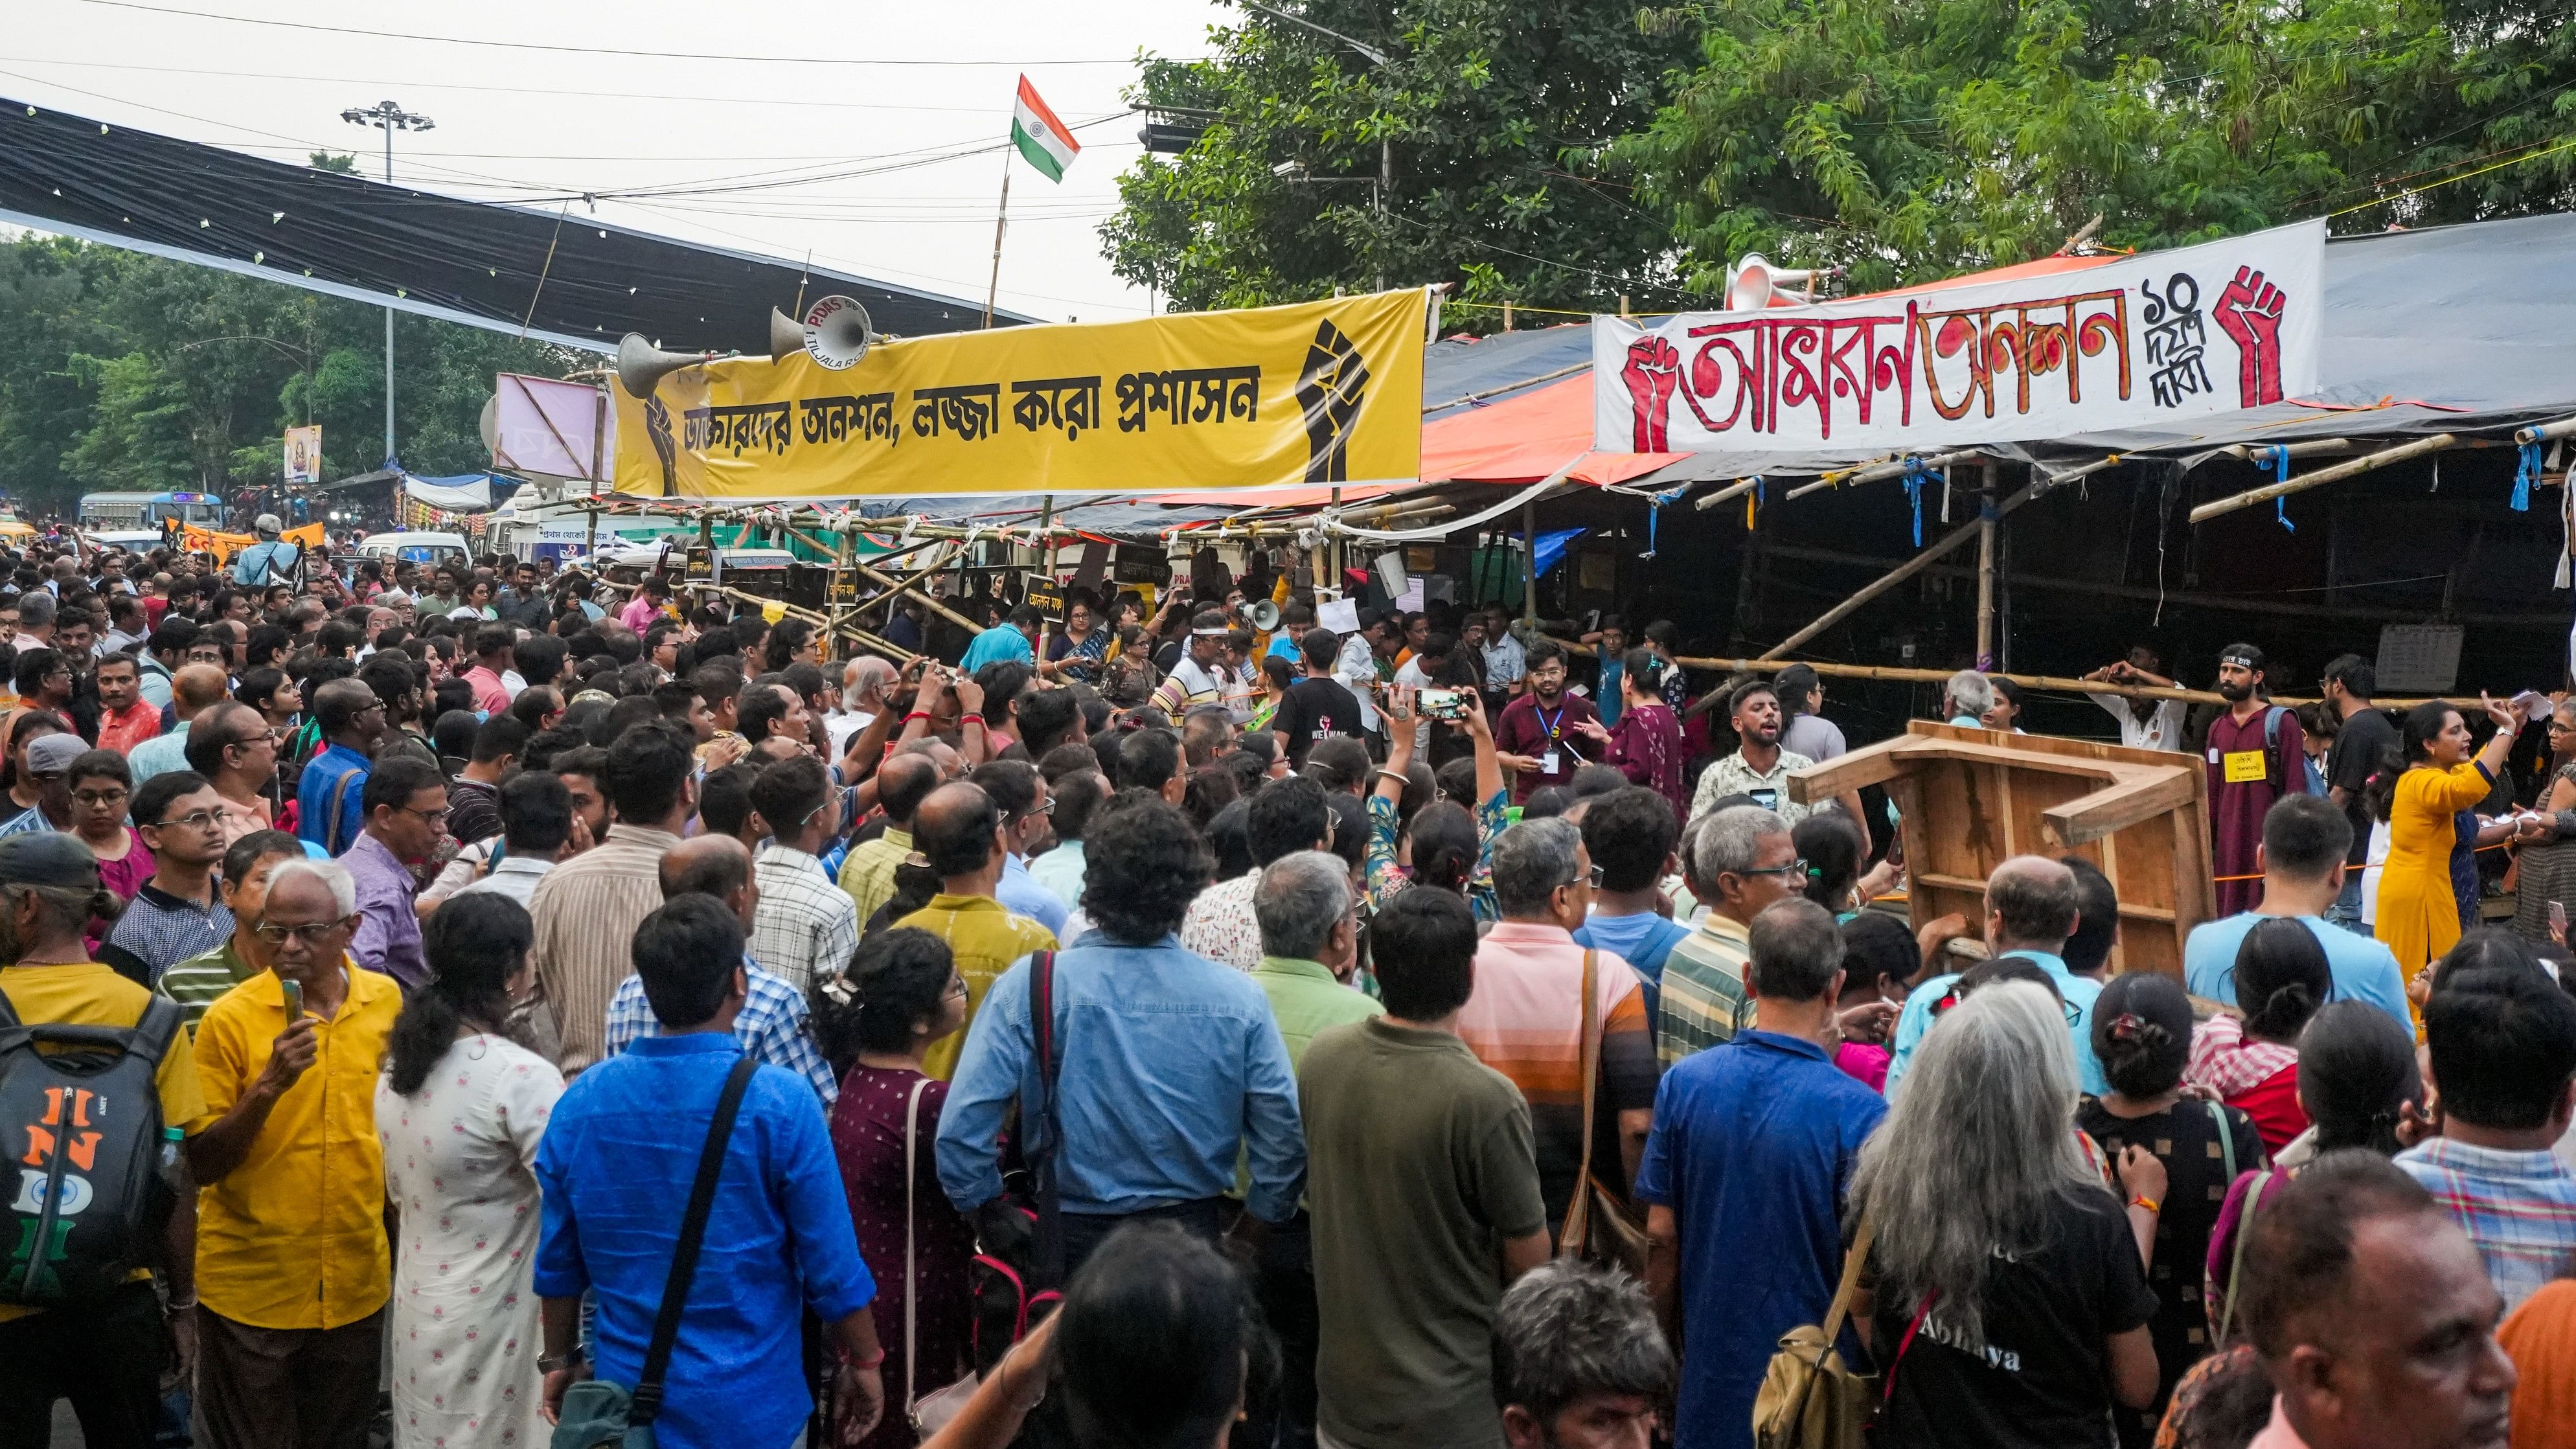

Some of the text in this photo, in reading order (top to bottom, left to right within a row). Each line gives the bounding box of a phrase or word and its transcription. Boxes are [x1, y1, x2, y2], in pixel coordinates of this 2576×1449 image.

[2141, 272, 2200, 325] ১০
[807, 339, 842, 368] TILJALA
[1917, 288, 2132, 420] অনশন
[684, 401, 791, 458] ডাক্তারদের
[799, 392, 900, 448] অনশন,
[912, 383, 1000, 442] লজ্জা
[1012, 376, 1101, 442] করো
[1115, 365, 1261, 433] প্রশাসন
[563, 531, 586, 540] থেকেই
[1029, 593, 1062, 611] অনশন মঞ্চ
[1312, 730, 1323, 740] WE
